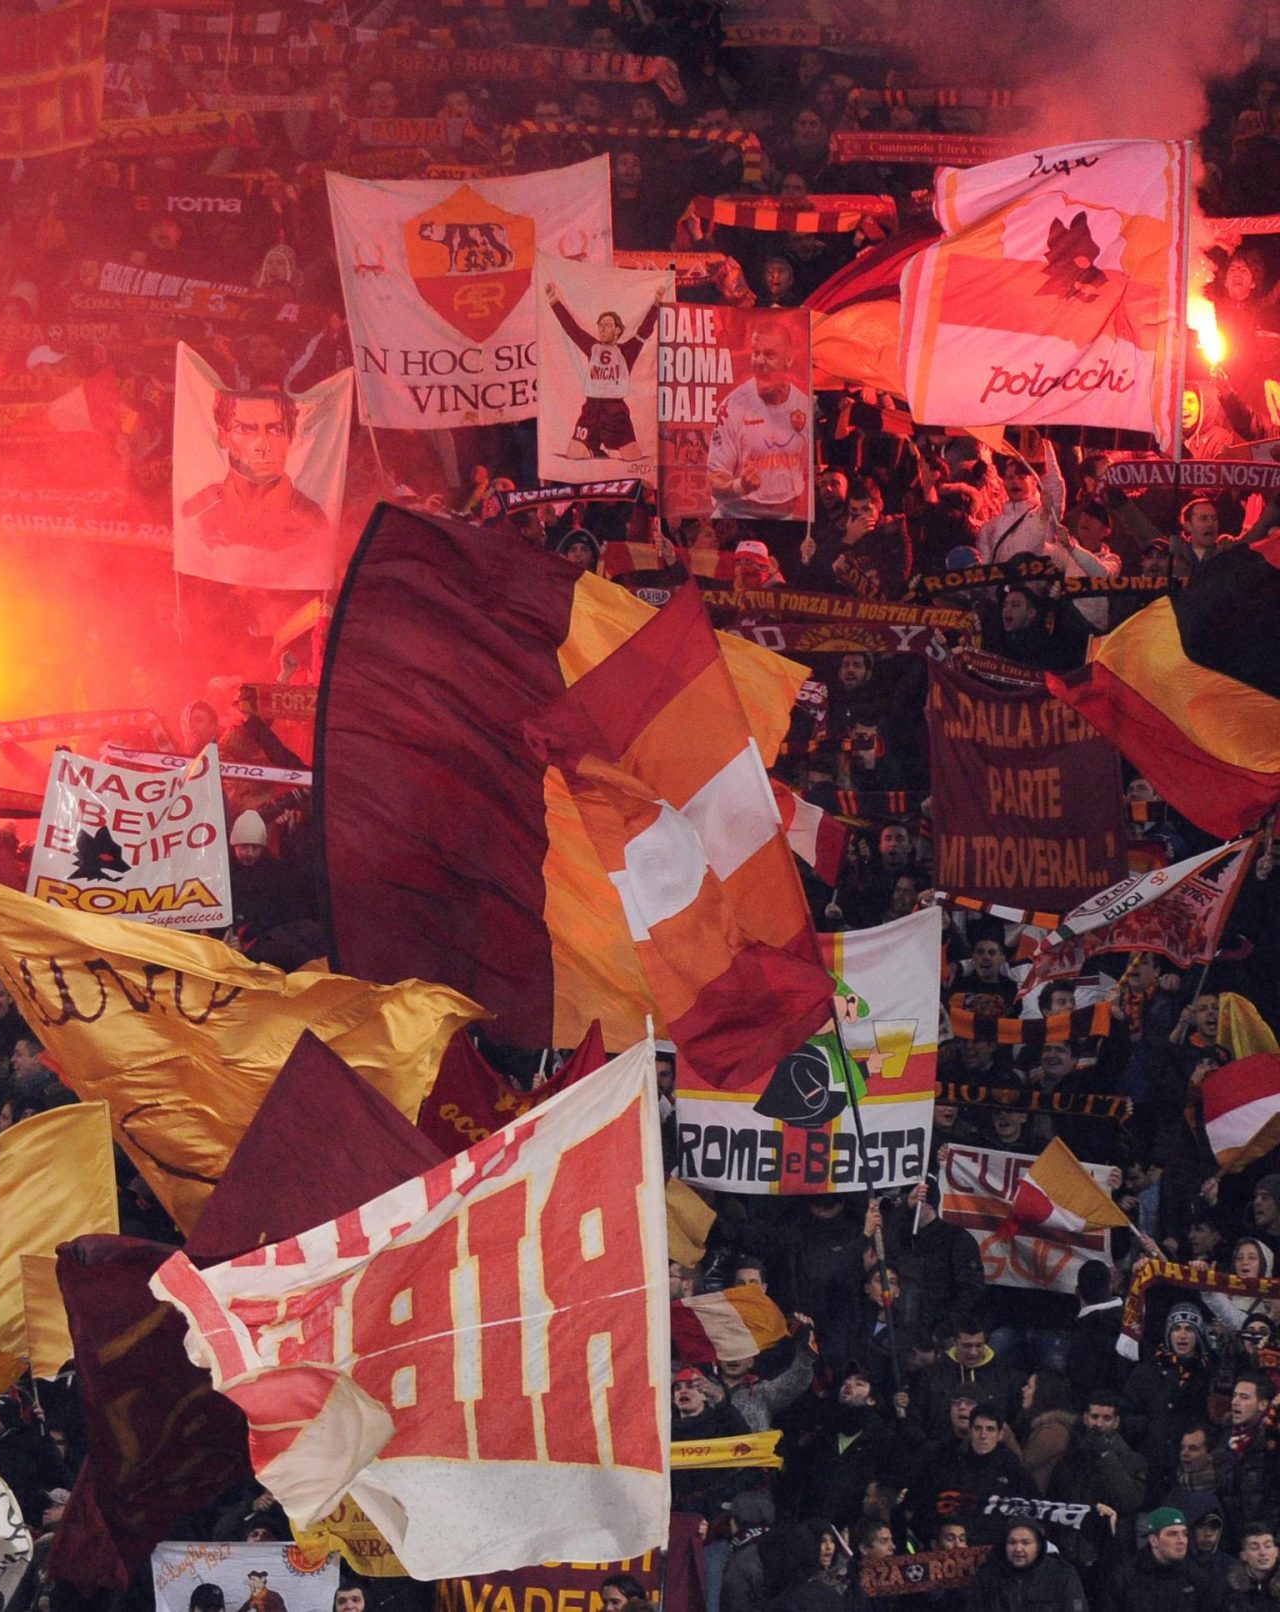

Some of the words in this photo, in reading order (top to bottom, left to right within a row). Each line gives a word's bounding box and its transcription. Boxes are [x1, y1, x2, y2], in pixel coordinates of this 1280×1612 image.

[166, 195, 242, 214] roma
[659, 306, 717, 344] DAJE
[400, 346, 485, 377] HOC
[599, 350, 612, 365] 6
[658, 347, 733, 384] ROMA
[980, 360, 1136, 402] polacchi
[658, 386, 717, 424] DAJE
[576, 426, 588, 441] 10
[1107, 469, 1169, 489] ROMA
[924, 565, 1006, 593] ROMA
[780, 592, 829, 614] FORZA
[832, 599, 852, 616] LA
[857, 602, 918, 622] NOSTRA
[271, 690, 320, 712] FORZ
[219, 763, 265, 778] oma
[988, 765, 1063, 820] PARTE
[75, 793, 193, 836] BEVO
[43, 824, 74, 854] E
[123, 822, 217, 867] TIFO
[939, 834, 966, 888] MI
[31, 876, 223, 915] ROMA
[147, 910, 225, 929] Superciccio
